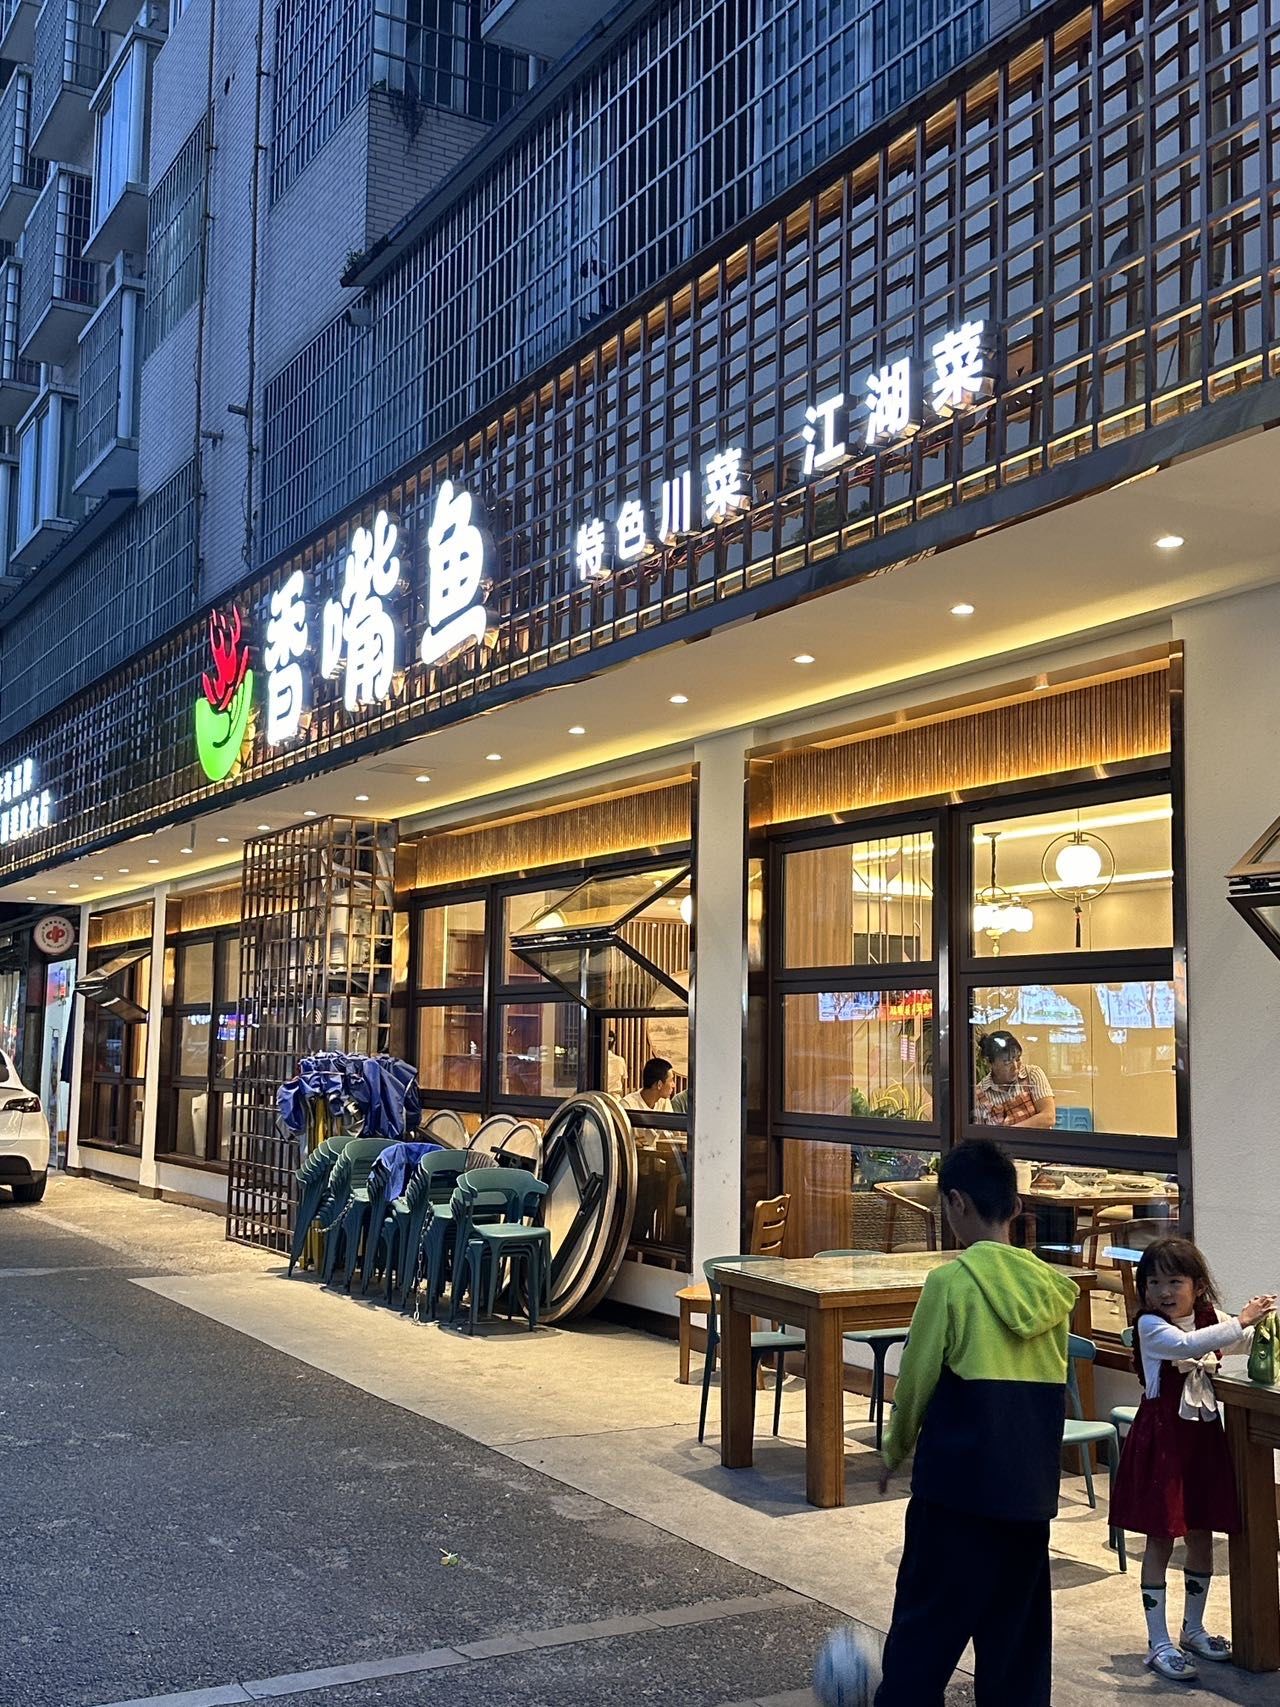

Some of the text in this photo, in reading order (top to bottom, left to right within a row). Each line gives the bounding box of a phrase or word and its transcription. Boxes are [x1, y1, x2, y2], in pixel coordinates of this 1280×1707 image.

[576, 320, 985, 581] 特色川菜 江湖菜
[264, 479, 487, 747] 香嘴鱼
